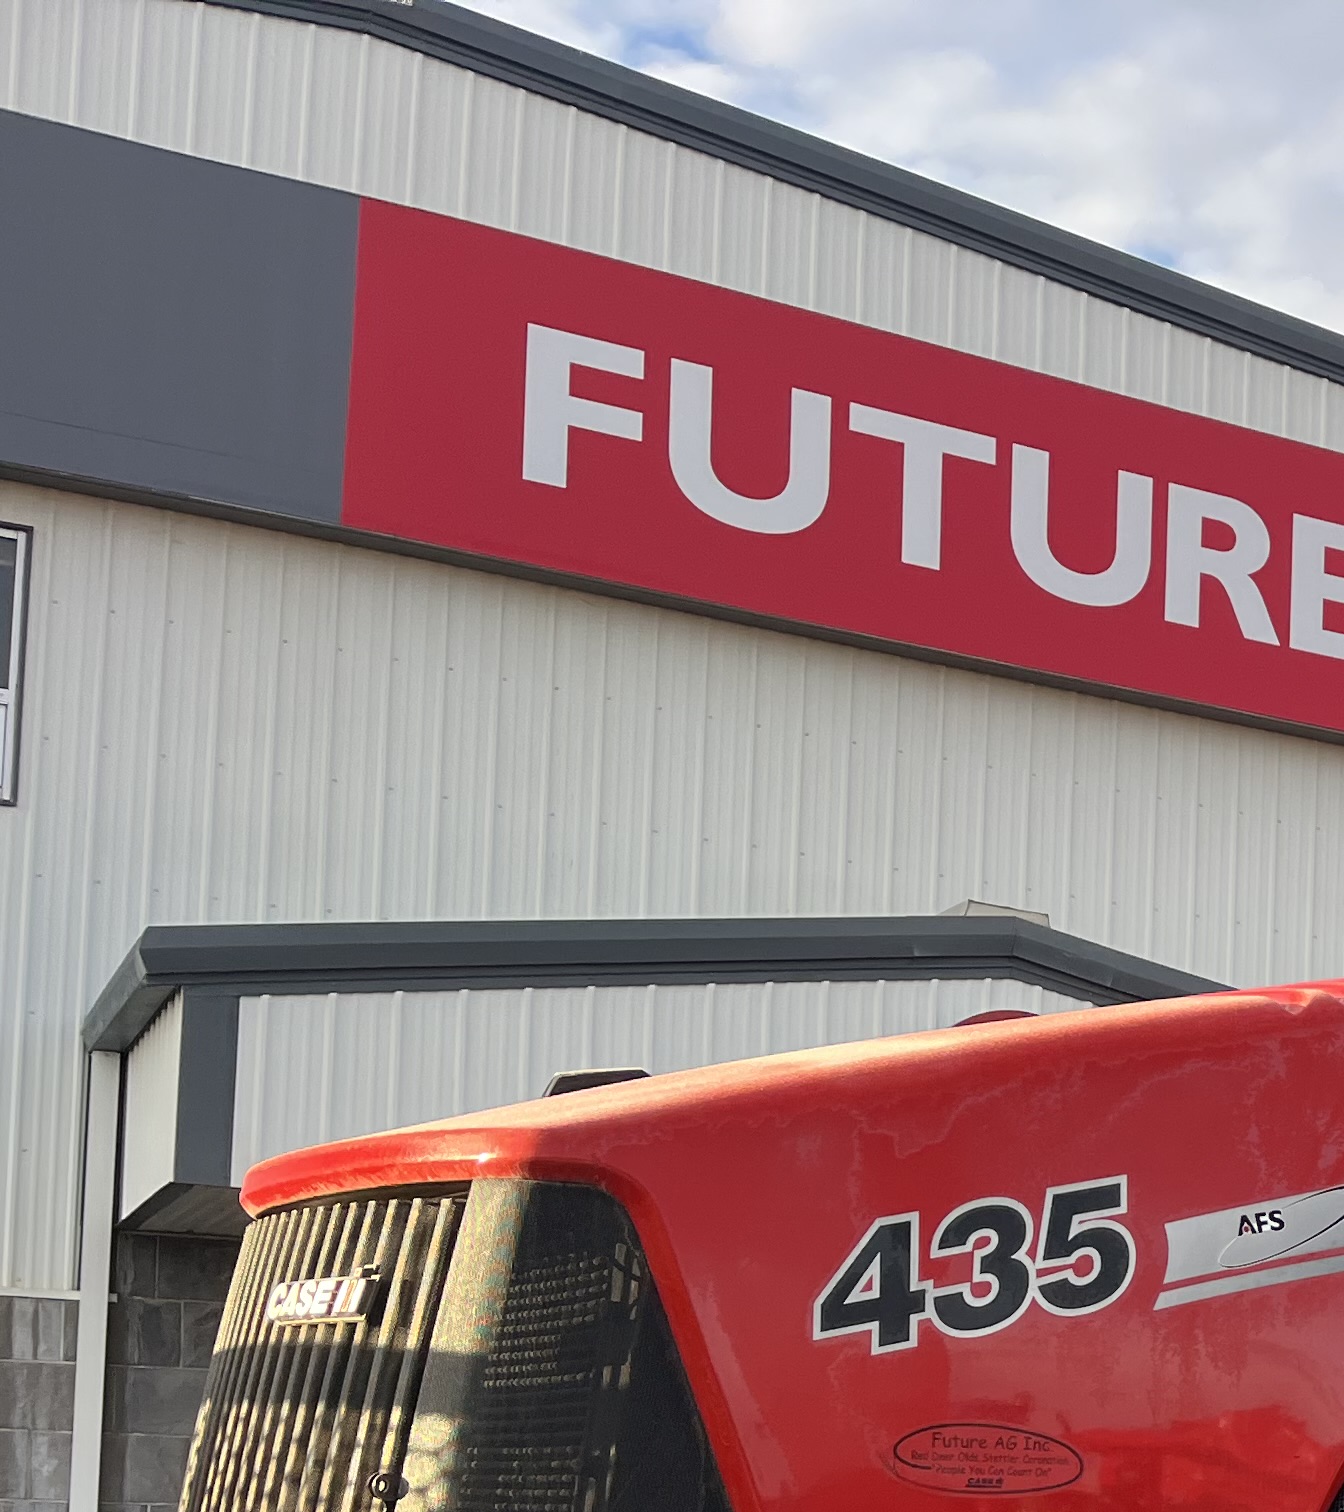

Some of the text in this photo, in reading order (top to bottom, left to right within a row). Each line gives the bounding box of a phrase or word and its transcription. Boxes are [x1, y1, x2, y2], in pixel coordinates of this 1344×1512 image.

[1237, 1209, 1286, 1237] AFS
[812, 1174, 1137, 1356] 435
[931, 1431, 988, 1449] Future
[994, 1436, 1018, 1451] AG
